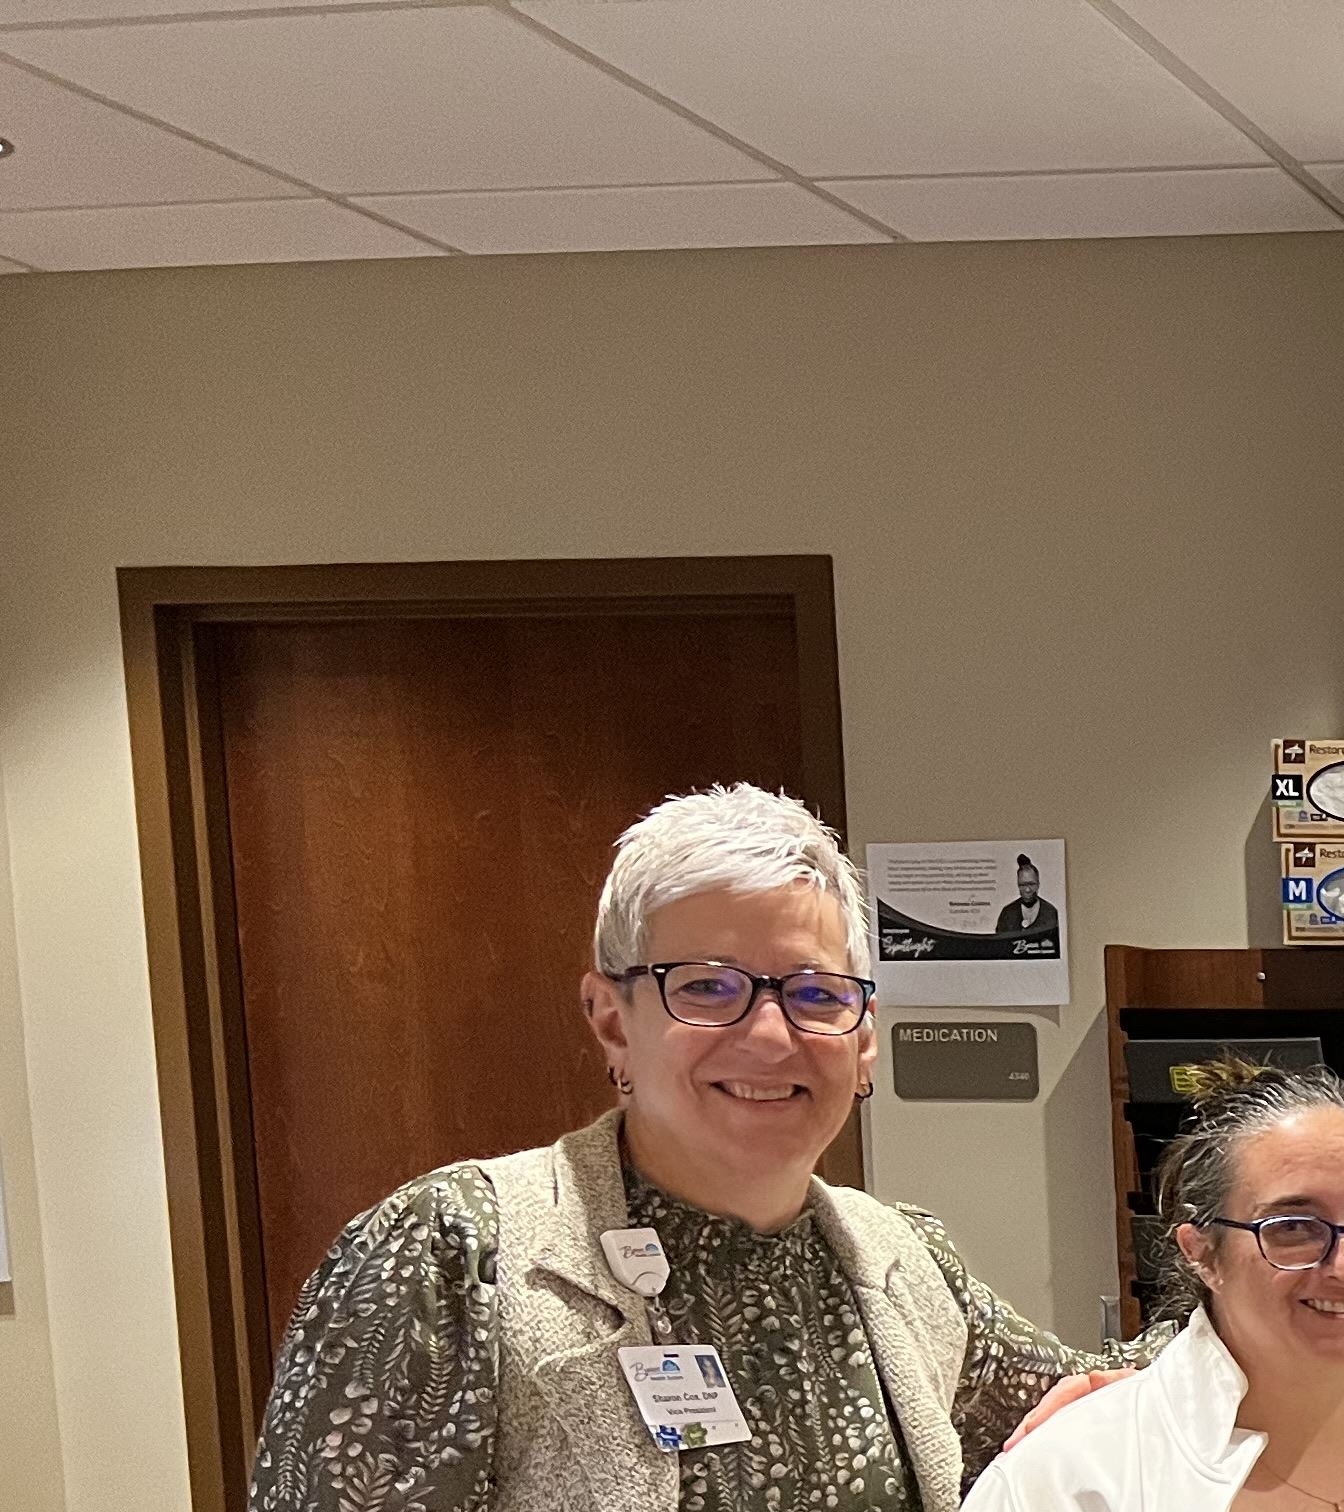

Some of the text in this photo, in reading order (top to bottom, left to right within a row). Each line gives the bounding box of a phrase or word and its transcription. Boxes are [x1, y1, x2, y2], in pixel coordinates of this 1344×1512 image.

[1275, 779, 1299, 797] XL
[1288, 880, 1307, 900] M
[900, 1028, 998, 1042] MEDICATION
